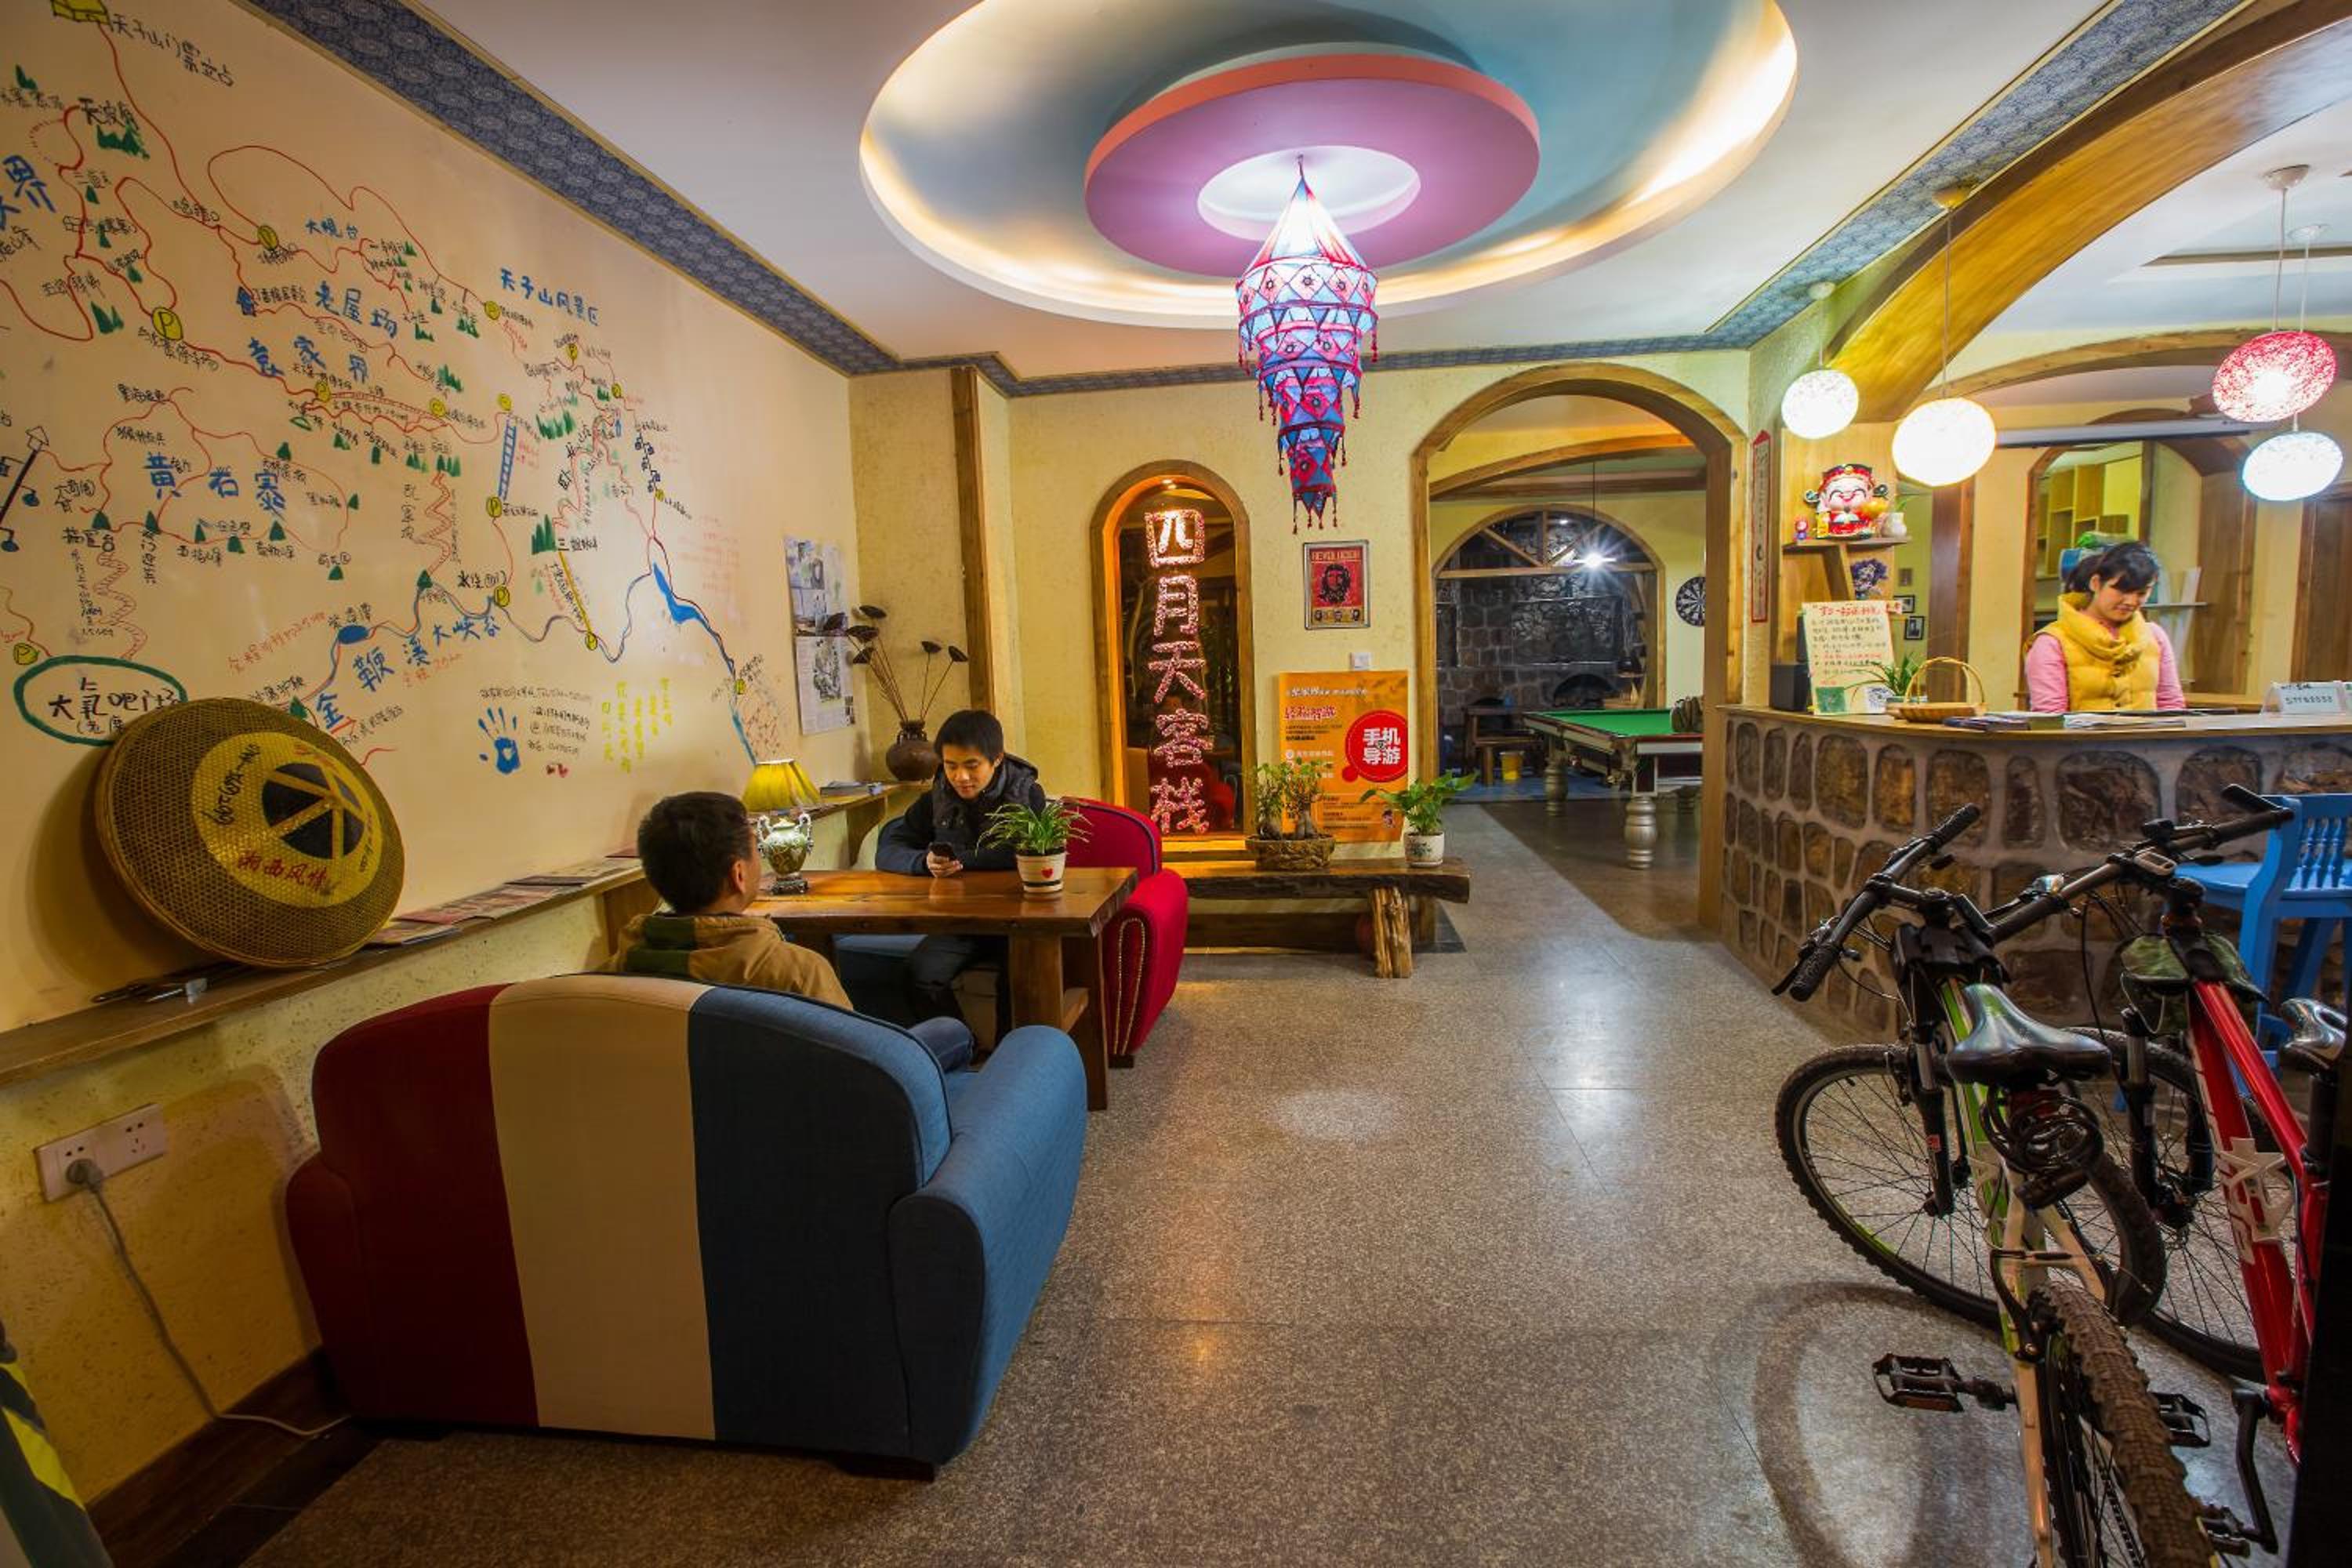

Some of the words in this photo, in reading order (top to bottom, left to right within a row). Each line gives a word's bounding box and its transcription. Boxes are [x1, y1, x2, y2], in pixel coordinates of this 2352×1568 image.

[315, 280, 397, 338] 老屋场
[501, 268, 598, 326] 天子山风景区
[1144, 508, 1214, 835] 四月天客栈
[1363, 727, 1401, 746] 手机
[1363, 746, 1401, 766] 导游
